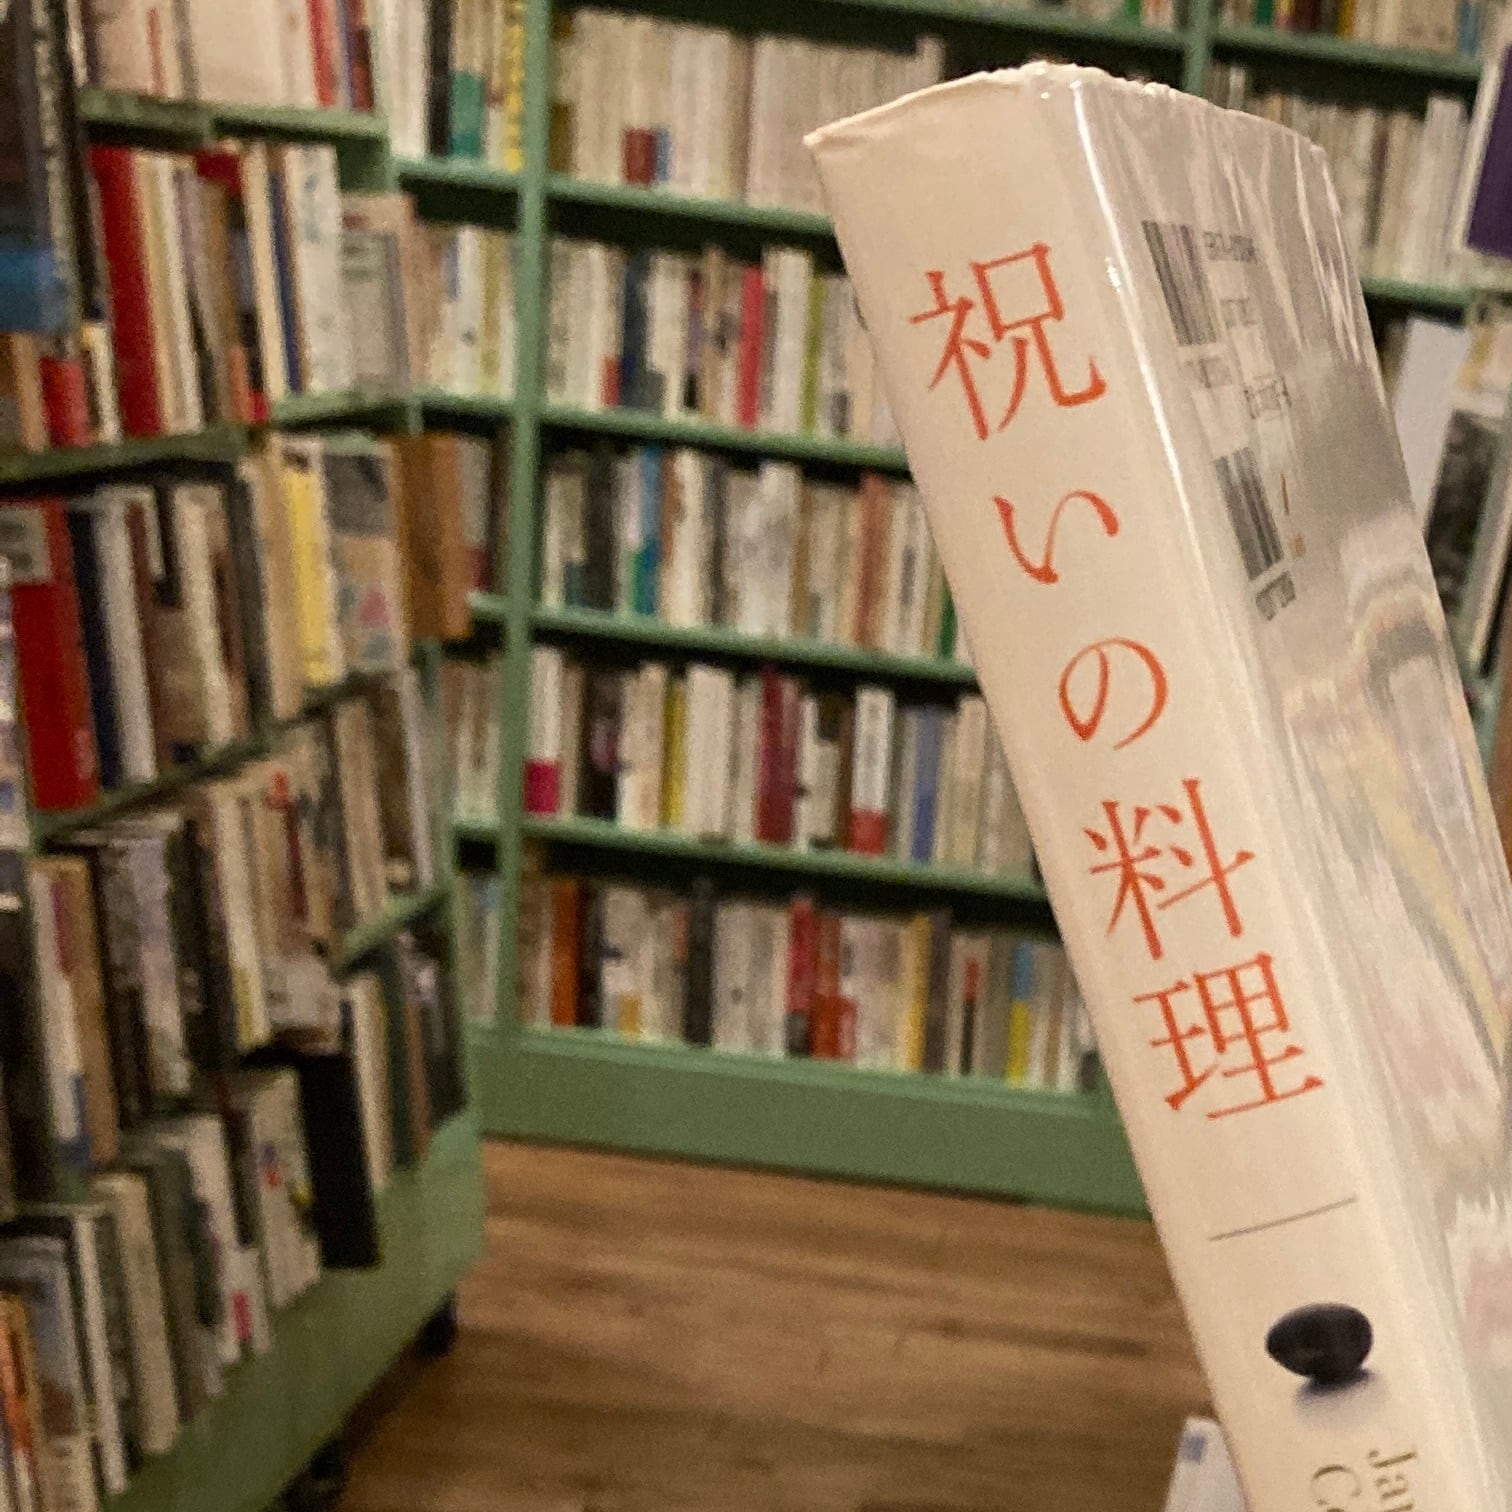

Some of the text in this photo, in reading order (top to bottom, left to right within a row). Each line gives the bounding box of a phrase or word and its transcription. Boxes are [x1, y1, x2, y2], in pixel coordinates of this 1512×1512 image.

[907, 242, 1323, 1120] 祝いの料理
